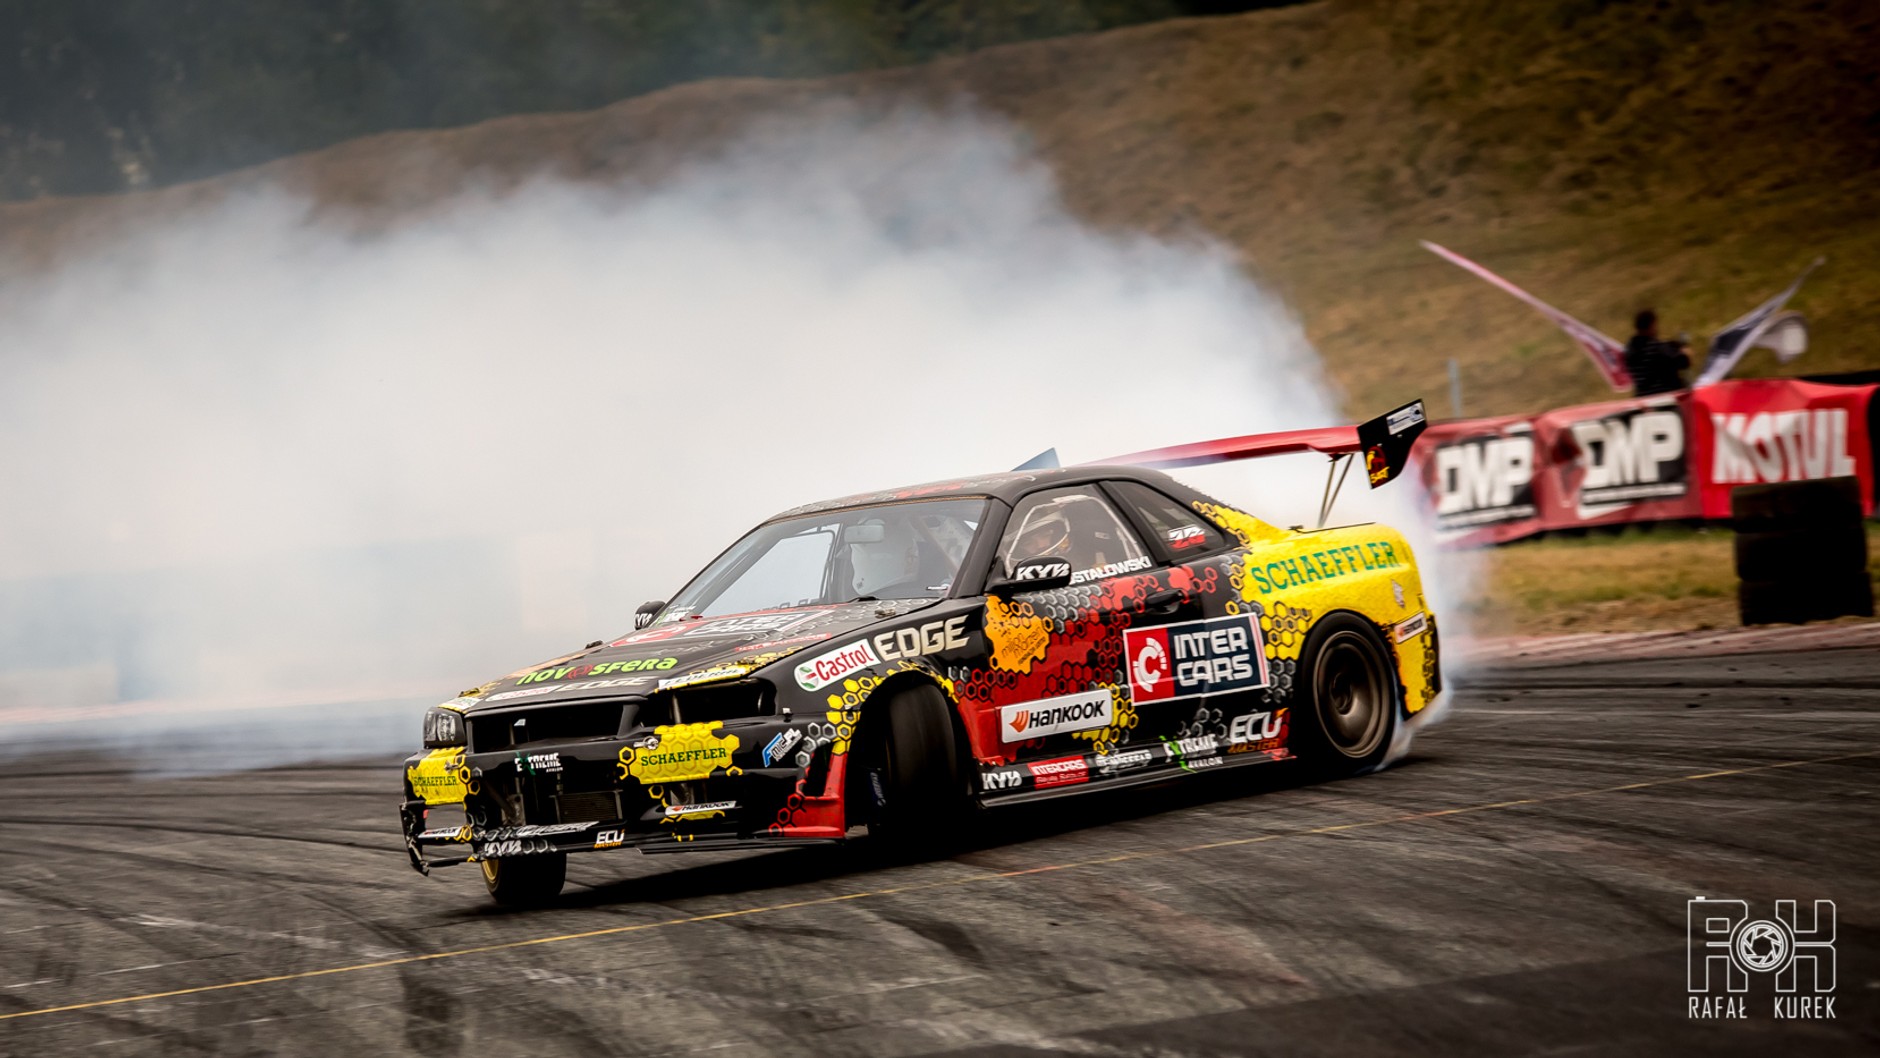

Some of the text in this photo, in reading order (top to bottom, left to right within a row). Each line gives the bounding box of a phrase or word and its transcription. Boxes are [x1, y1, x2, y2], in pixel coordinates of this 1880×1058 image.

[1712, 409, 1856, 485] MOTUL
[1016, 563, 1070, 581] KYB
[1251, 541, 1402, 594] SCHAEFFLER
[873, 614, 970, 661] EDGE
[1174, 626, 1249, 659] INTER
[815, 644, 875, 682] Castrol
[1176, 656, 1254, 687] CARS
[1230, 710, 1282, 743] ECU
[641, 747, 727, 767] SCHAEFFLER
[413, 775, 458, 786] SCHAEFFLER
[981, 770, 1022, 790] KYB
[596, 830, 624, 844] ECU
